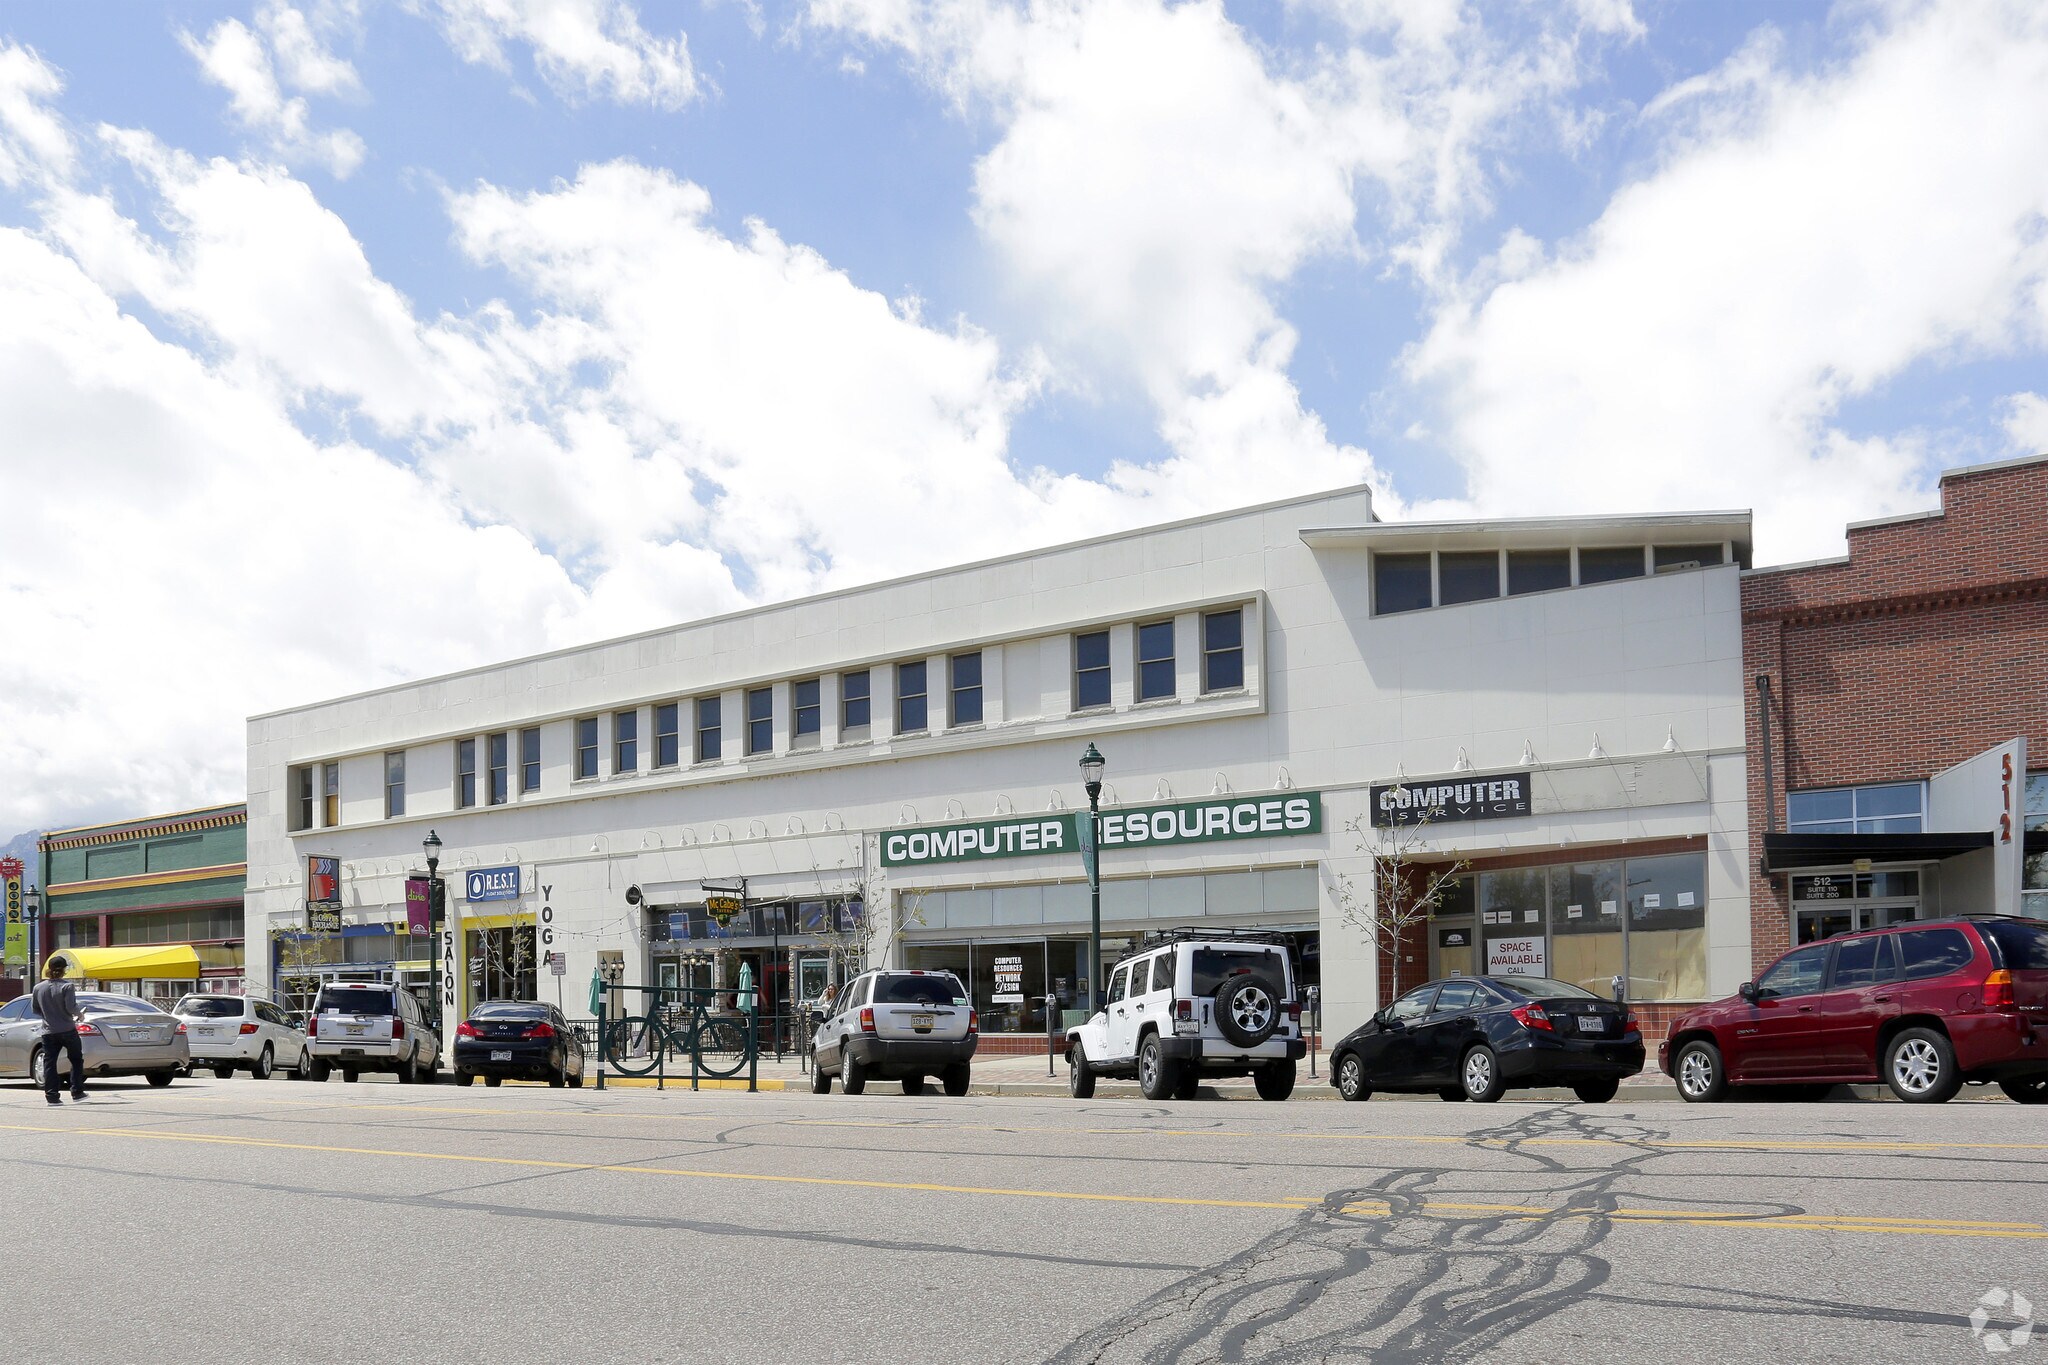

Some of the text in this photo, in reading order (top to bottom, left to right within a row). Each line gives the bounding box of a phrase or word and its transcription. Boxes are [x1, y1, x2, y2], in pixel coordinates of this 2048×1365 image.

[1380, 780, 1520, 810] COMPUTER
[2000, 753, 2012, 843] 512
[1399, 803, 1526, 819] SERVICE
[887, 799, 1311, 861] COMPUTER ESOURCES
[486, 872, 516, 890] R.E.S.T.
[1813, 877, 1831, 886] 512
[407, 888, 425, 901] dine
[541, 885, 553, 966] YOGA
[1500, 942, 1532, 953] SPACE
[994, 956, 1022, 964] COMPUTER
[1490, 954, 1543, 966] AVAILABLE
[444, 931, 454, 1006] SALON
[993, 964, 1023, 972] RESOURCES
[994, 973, 1021, 982] NETWORK
[995, 981, 1020, 993] DESIGN
